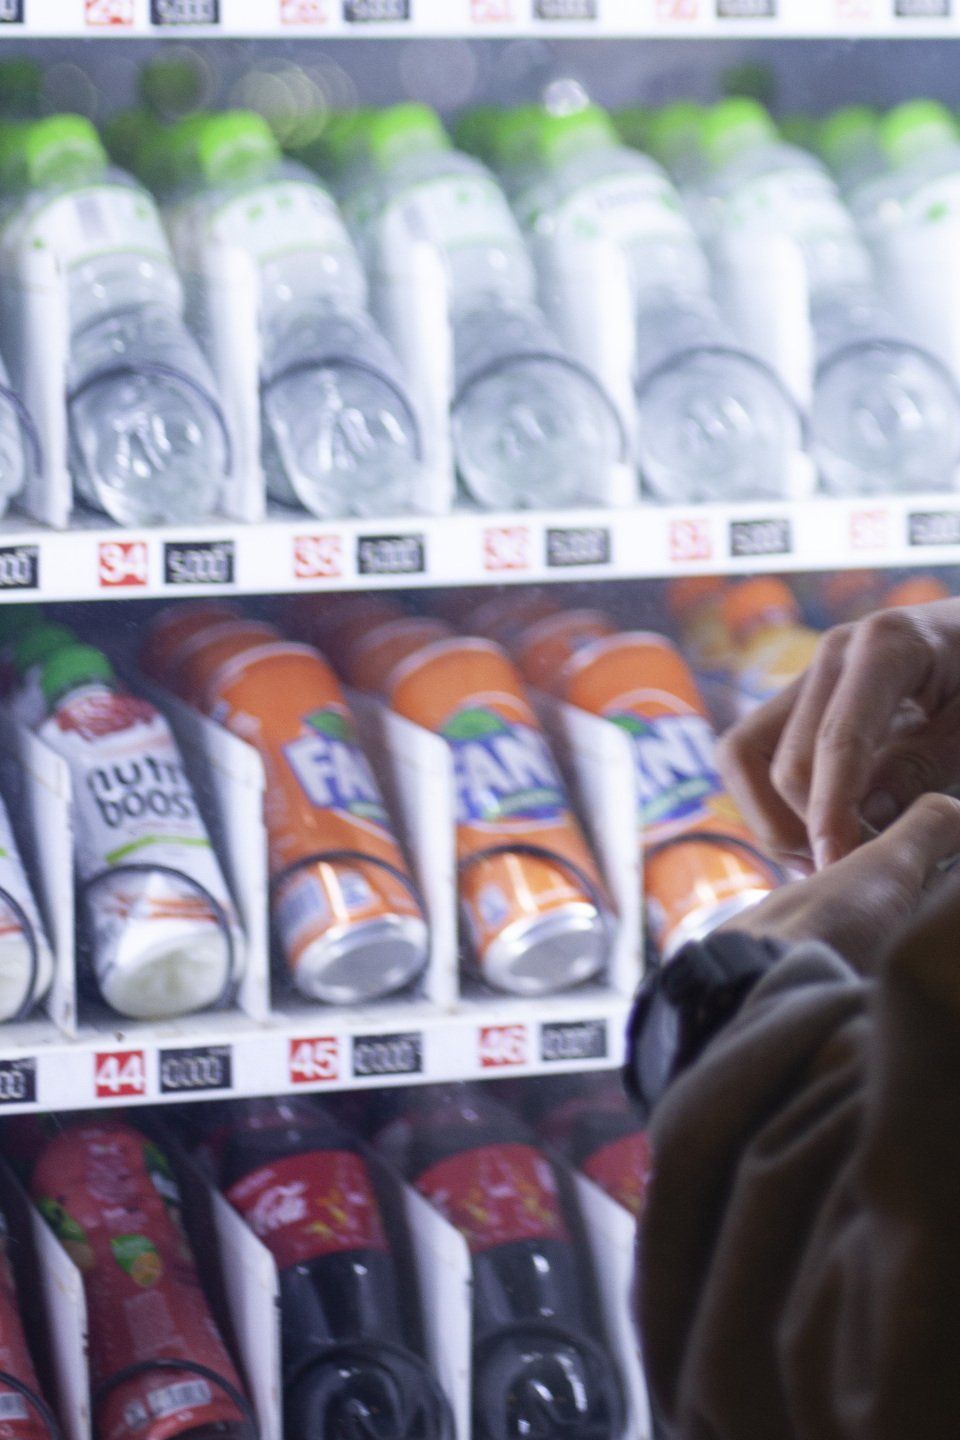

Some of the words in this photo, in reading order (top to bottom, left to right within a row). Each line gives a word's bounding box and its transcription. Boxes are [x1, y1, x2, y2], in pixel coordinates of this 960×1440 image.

[99, 545, 147, 586] 34
[95, 789, 193, 829] boos
[96, 1053, 145, 1097] 44
[291, 1040, 338, 1083] 45
